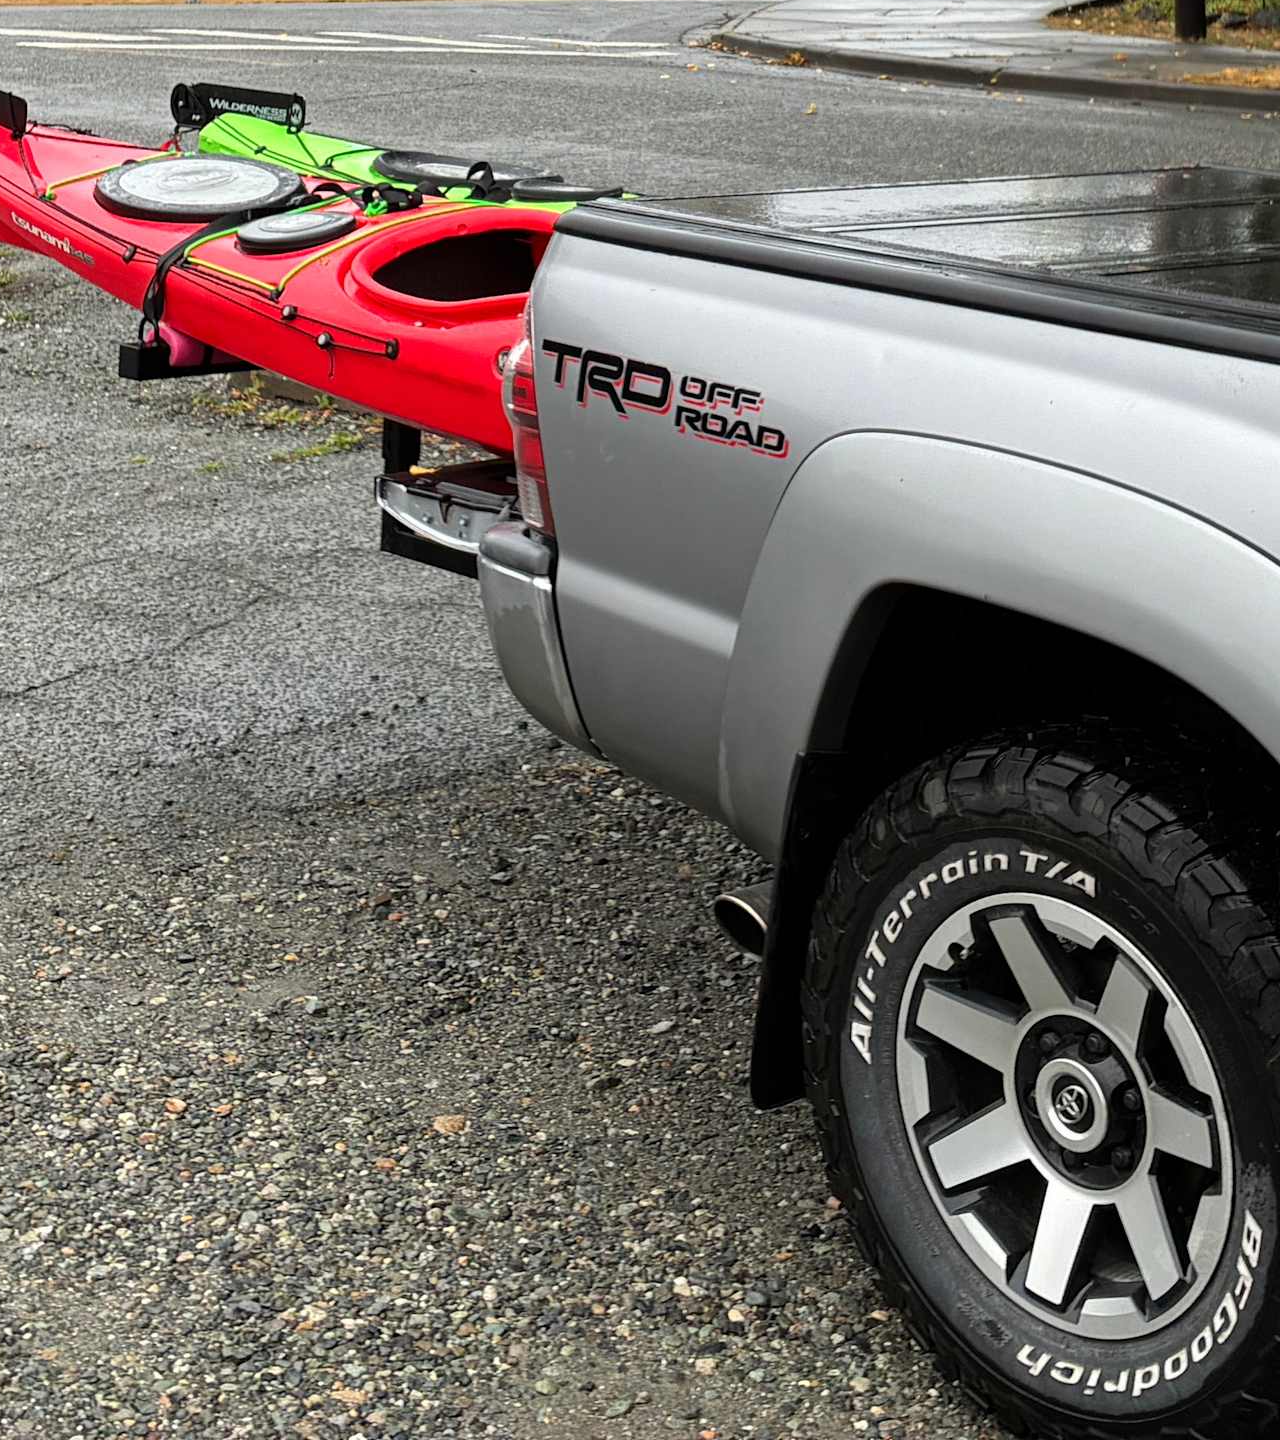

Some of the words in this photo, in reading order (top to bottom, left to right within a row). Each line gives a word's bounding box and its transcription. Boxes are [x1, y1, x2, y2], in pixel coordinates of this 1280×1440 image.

[11, 211, 71, 254] tsunami
[542, 339, 674, 418] TRD
[680, 375, 763, 414] OFF
[675, 405, 789, 458] ROAD
[850, 850, 1009, 1064] All-Terrain
[1019, 850, 1097, 898] T/A
[1016, 1209, 1263, 1397] BFGoodrich
